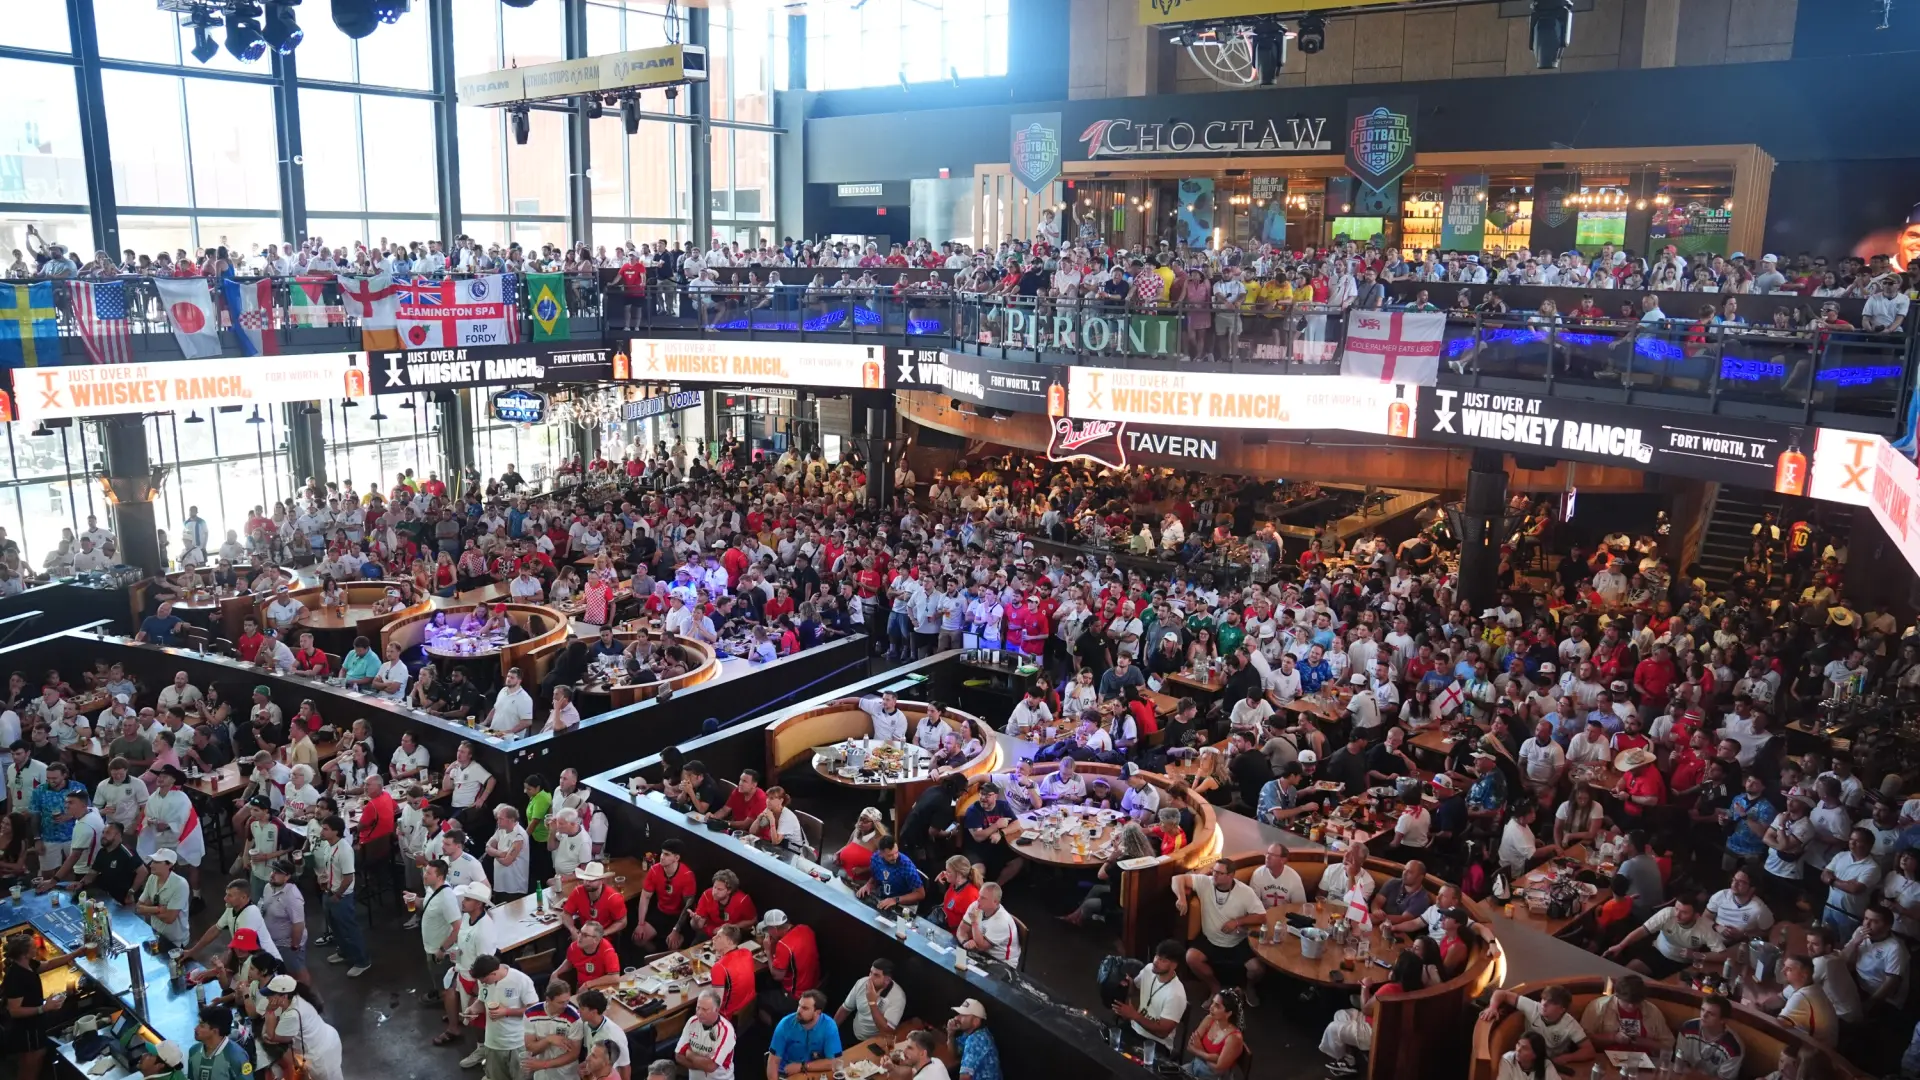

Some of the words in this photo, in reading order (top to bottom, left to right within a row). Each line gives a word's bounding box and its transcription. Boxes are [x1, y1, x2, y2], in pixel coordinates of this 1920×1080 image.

[631, 57, 675, 71] RAM
[549, 70, 569, 84] STOPS
[583, 66, 600, 80] RAM
[476, 80, 509, 93] RAM
[1106, 117, 1326, 152] CHOCTAW
[1354, 129, 1408, 143] FOOTBALL
[1015, 141, 1056, 153] FOOTBALL
[1253, 176, 1270, 185] HOME
[1270, 176, 1278, 185] OF
[1253, 183, 1284, 192] BEAUTIFUL
[1252, 191, 1273, 199] GAMES
[1452, 185, 1480, 196] WE'RE
[1451, 195, 1467, 205] ALL
[1469, 195, 1479, 205] IN
[1449, 205, 1462, 215] ON
[1463, 205, 1480, 215] THE
[1448, 215, 1480, 225] WORLD
[1454, 225, 1473, 235] CUP
[400, 307, 472, 317] LEAMINGTON
[475, 306, 496, 316] SPA
[472, 324, 488, 333] RIP
[1005, 308, 1169, 354] PERONI
[465, 333, 497, 344] FORDY
[1352, 340, 1370, 349] COLE
[1371, 342, 1397, 351] PALMER
[1398, 344, 1415, 352] EATS
[1416, 344, 1433, 353] LEGO
[407, 352, 428, 364] JUST
[430, 351, 454, 362] OVER
[457, 349, 467, 360] AT
[553, 354, 570, 364] FORT
[572, 353, 596, 364] WORTH,
[597, 352, 606, 361] TX
[918, 350, 937, 362] JUST
[407, 360, 481, 386] WHISKEY
[485, 356, 537, 380] RANCH
[664, 355, 728, 374] WHISKEY
[732, 355, 781, 375] RANCH
[68, 368, 95, 383] JUST
[100, 366, 131, 380] OVER
[136, 366, 148, 379] AT
[1111, 373, 1136, 386] JUST
[1140, 374, 1168, 387] OVER
[1173, 375, 1185, 388] AT
[990, 376, 1004, 387] FORT
[1005, 378, 1029, 391] WORTH,
[1031, 380, 1040, 391] TX
[69, 379, 168, 407] WHISKEY
[175, 376, 242, 402] RANCH
[627, 400, 645, 420] DEEP
[645, 396, 664, 416] EDDY
[671, 391, 700, 409] VODKA
[1111, 388, 1203, 416] WHISKEY
[1209, 393, 1281, 419] RANCH
[1463, 391, 1490, 410] JUST
[1493, 395, 1523, 413] OVER
[1527, 399, 1542, 414] AT
[1056, 418, 1117, 445] Miller
[1462, 408, 1559, 447] WHISKEY
[1561, 420, 1642, 459] RANCH
[1127, 430, 1217, 459] TAVERN
[1670, 432, 1700, 449] FORT
[1702, 436, 1747, 458] WORTH,
[1750, 443, 1765, 459] TX
[1793, 531, 1808, 547] 10
[1370, 697, 1378, 716] 7
[409, 825, 414, 834] 7
[883, 883, 891, 895] 10
[1263, 883, 1288, 894] ENGLAND
[482, 988, 488, 1000] 9
